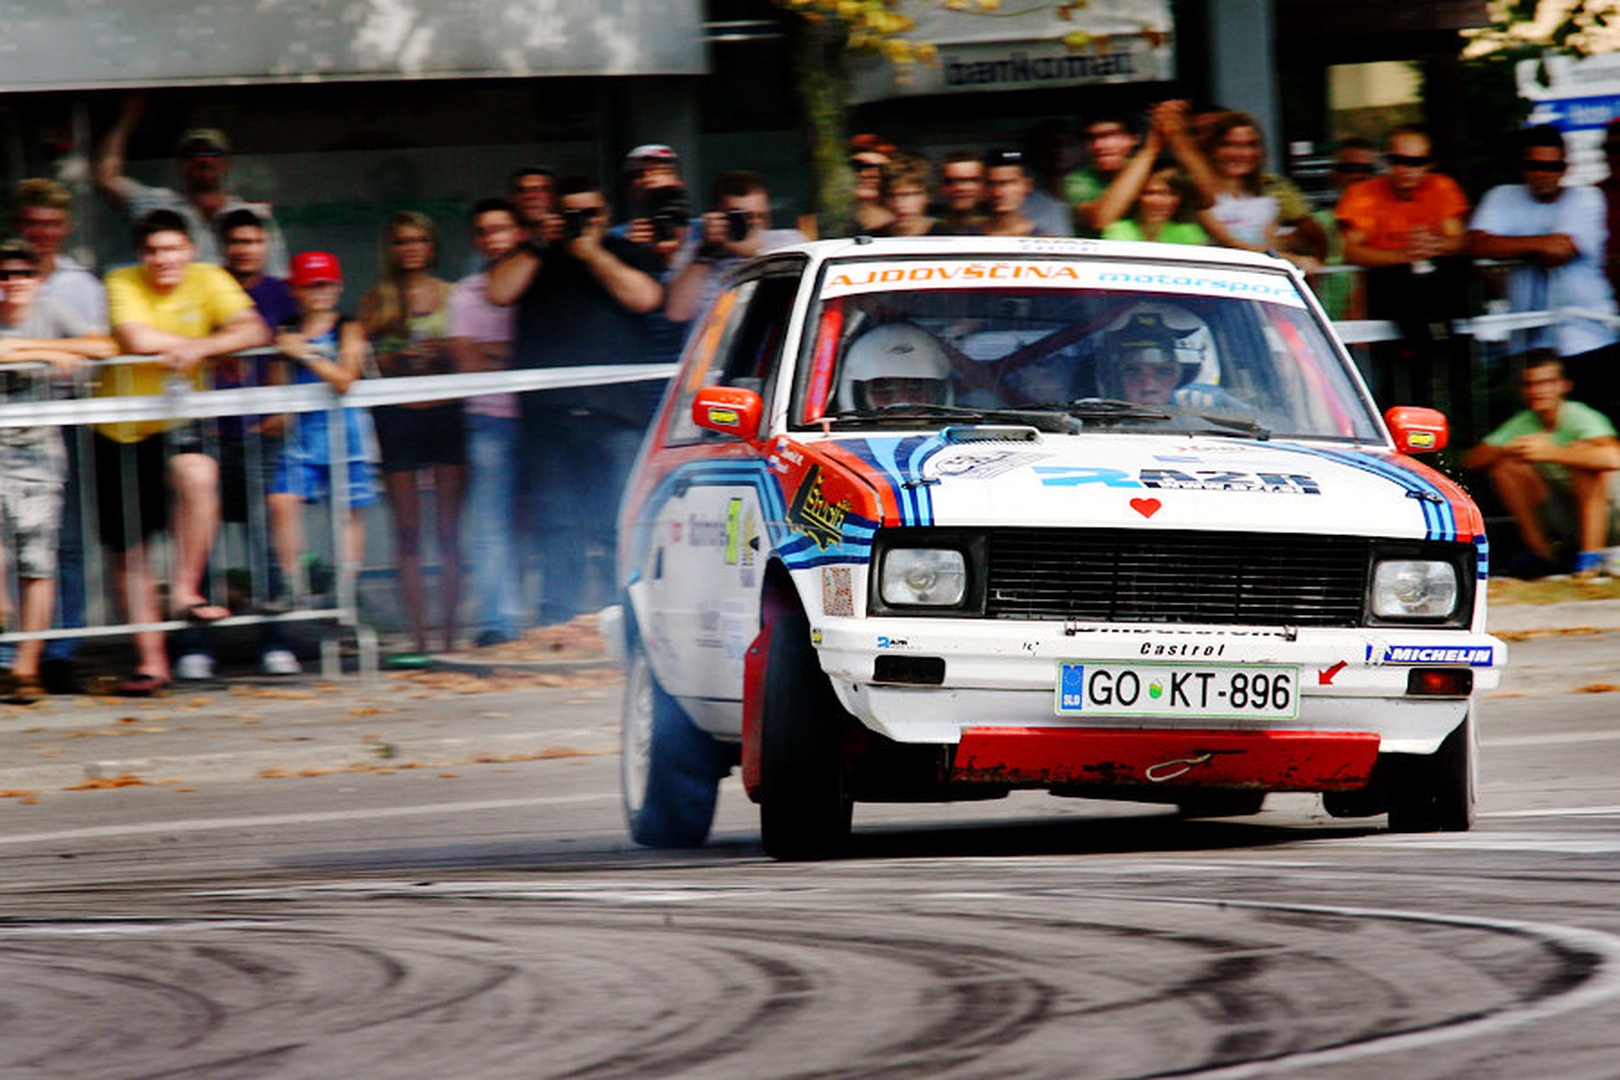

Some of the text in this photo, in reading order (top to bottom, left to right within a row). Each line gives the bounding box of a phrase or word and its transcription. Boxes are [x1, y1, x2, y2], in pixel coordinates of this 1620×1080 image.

[825, 262, 1080, 289] AJDOVŠČINA
[1140, 642, 1226, 657] Castrol
[1391, 647, 1491, 662] MICHELIN
[1088, 670, 1140, 706] GO
[1169, 672, 1291, 710] KT-896
